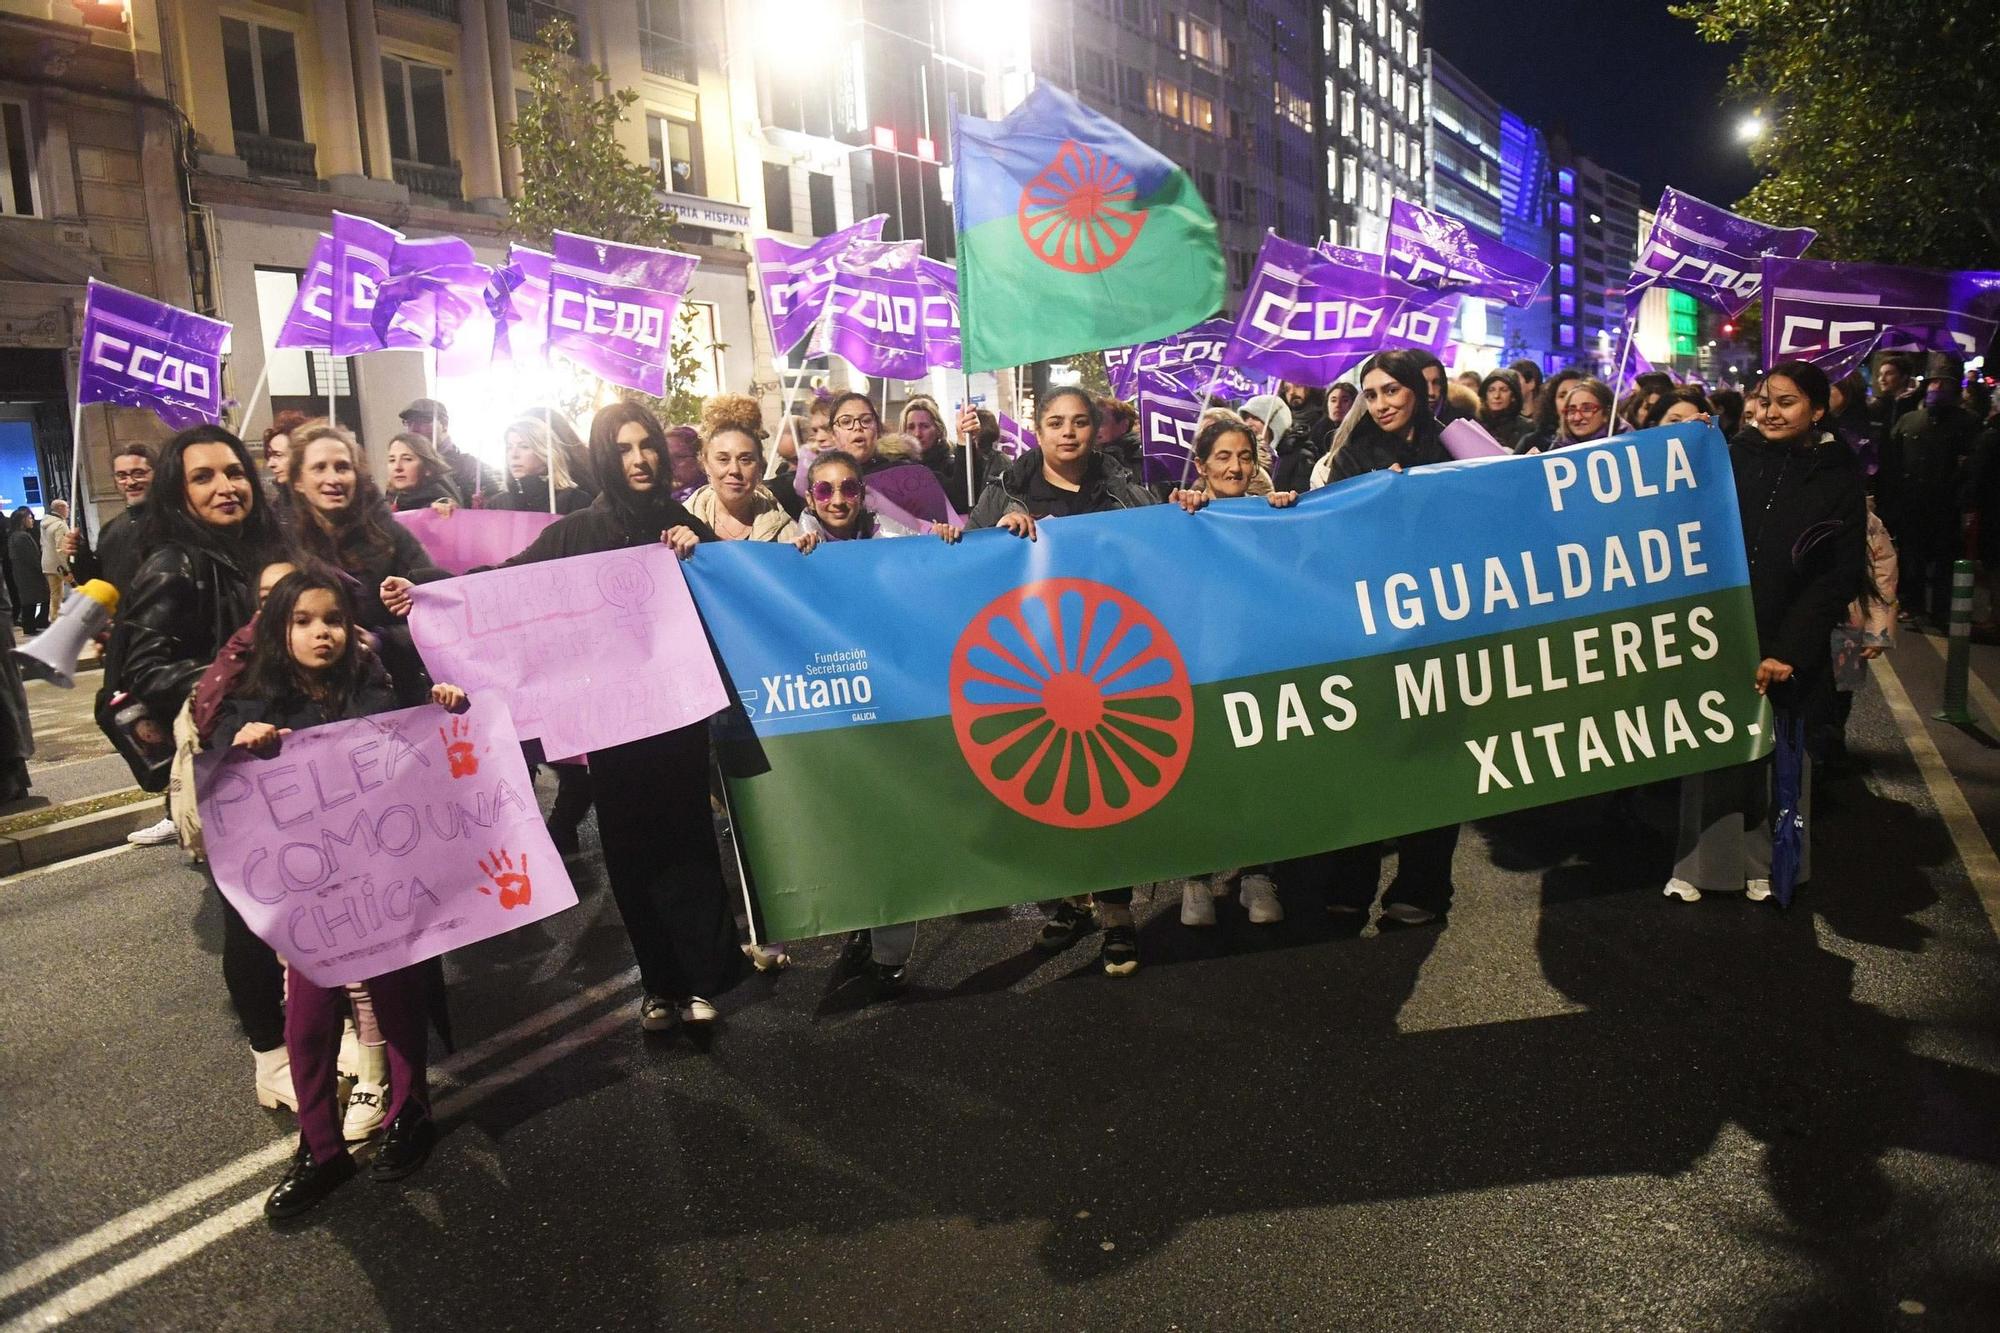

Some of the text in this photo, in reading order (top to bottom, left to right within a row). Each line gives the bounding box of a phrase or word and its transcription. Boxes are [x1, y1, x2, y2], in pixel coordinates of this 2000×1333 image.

[553, 291, 664, 347] CCOO
[1251, 290, 1383, 341] CCOO
[93, 331, 210, 399] CCOO
[1543, 437, 1697, 512] POLA
[1355, 520, 1708, 636] IGUALDADE
[805, 660, 869, 676] Secretariado
[814, 648, 867, 664] Fundación
[1223, 606, 1719, 748] DAS MULLERES
[761, 674, 872, 714] Xitano
[851, 711, 877, 722] GALICIA
[1464, 690, 1761, 795] XITANAS.
[208, 727, 431, 837] PELEA
